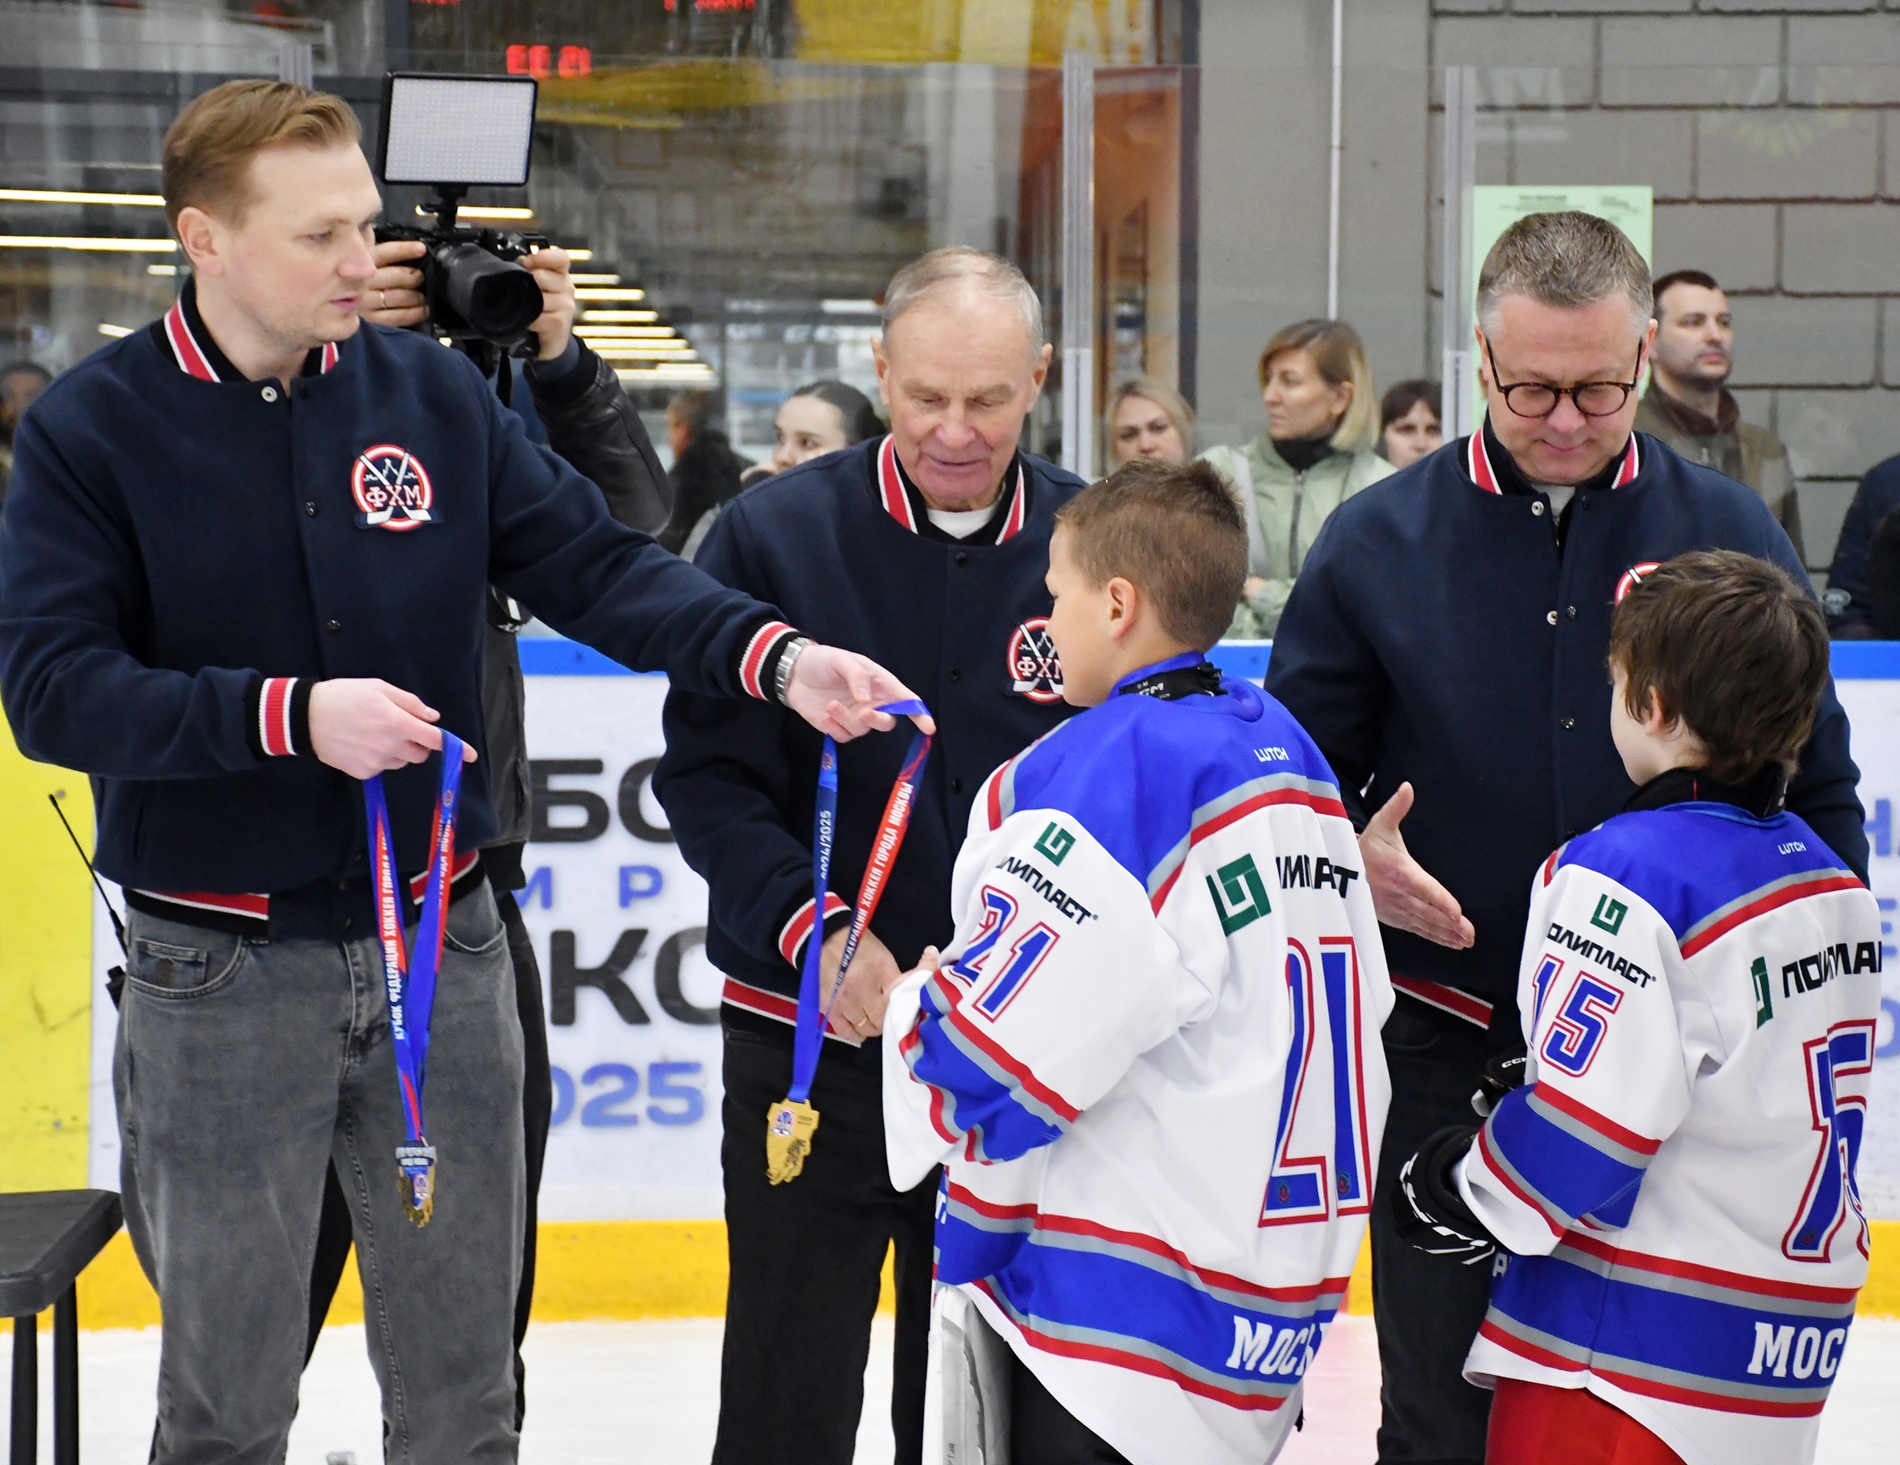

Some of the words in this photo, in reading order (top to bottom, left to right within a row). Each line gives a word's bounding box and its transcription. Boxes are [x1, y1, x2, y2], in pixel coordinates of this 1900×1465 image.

[365, 485, 423, 507] ФХМ
[1253, 746, 1290, 762] LUTCH
[860, 867, 883, 908] ХОККЕЯ
[873, 827, 898, 868] ГОРОДА
[888, 781, 914, 827] МОСКВЫ
[1777, 840, 1807, 856] LUTCH
[381, 896, 397, 937] ХОККЕЯ
[383, 940, 402, 1003] ФЕДЕРАЦИИ
[948, 884, 1061, 1024] 21
[390, 1005, 405, 1040] КУБОК
[1529, 953, 1625, 1078] 15
[1747, 1321, 1852, 1380] МОС
